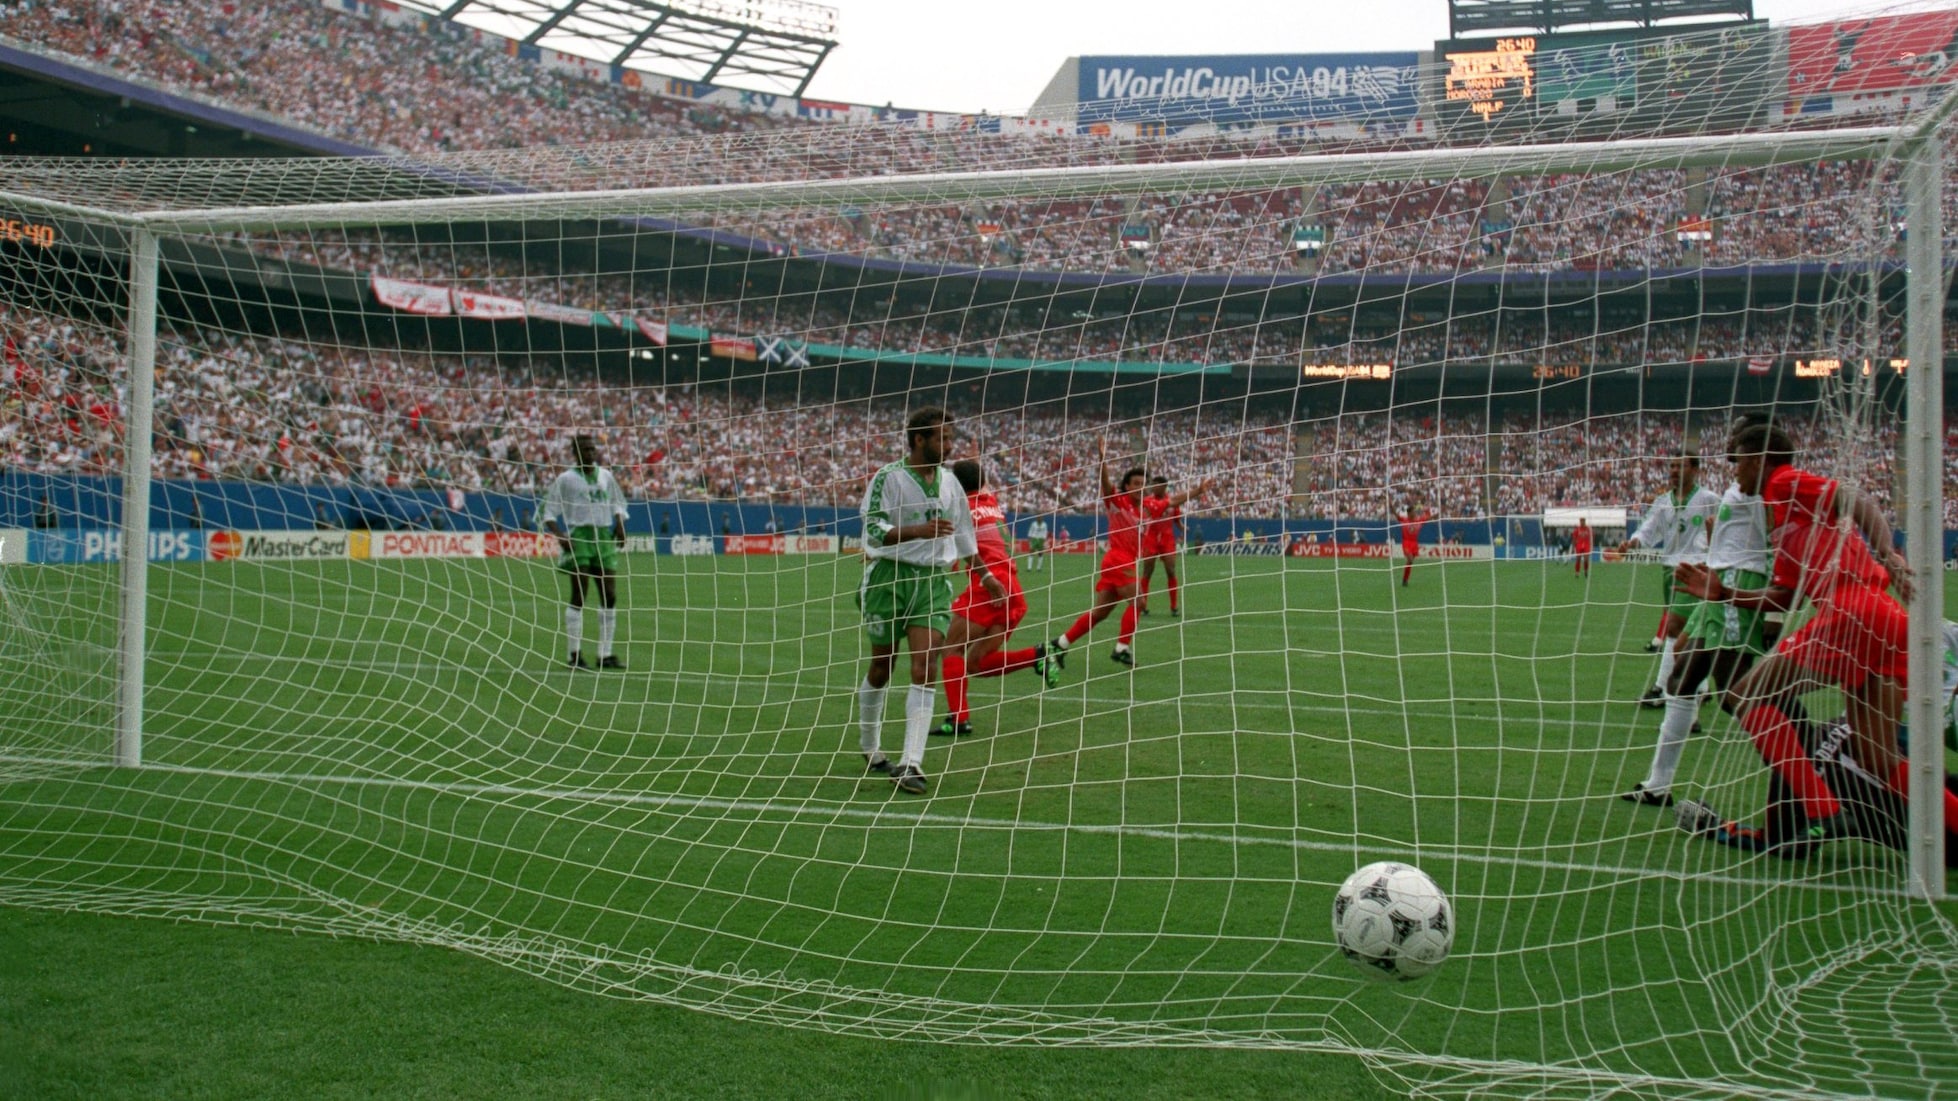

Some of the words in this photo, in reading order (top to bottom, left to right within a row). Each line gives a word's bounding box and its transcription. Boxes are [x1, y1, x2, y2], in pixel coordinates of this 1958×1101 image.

[245, 536, 347, 557] MasterCard
[384, 534, 473, 554] PONTIAC
[1202, 543, 1282, 555] SNICKERS
[1294, 544, 1320, 555] JVC
[1364, 544, 1391, 555] JVC
